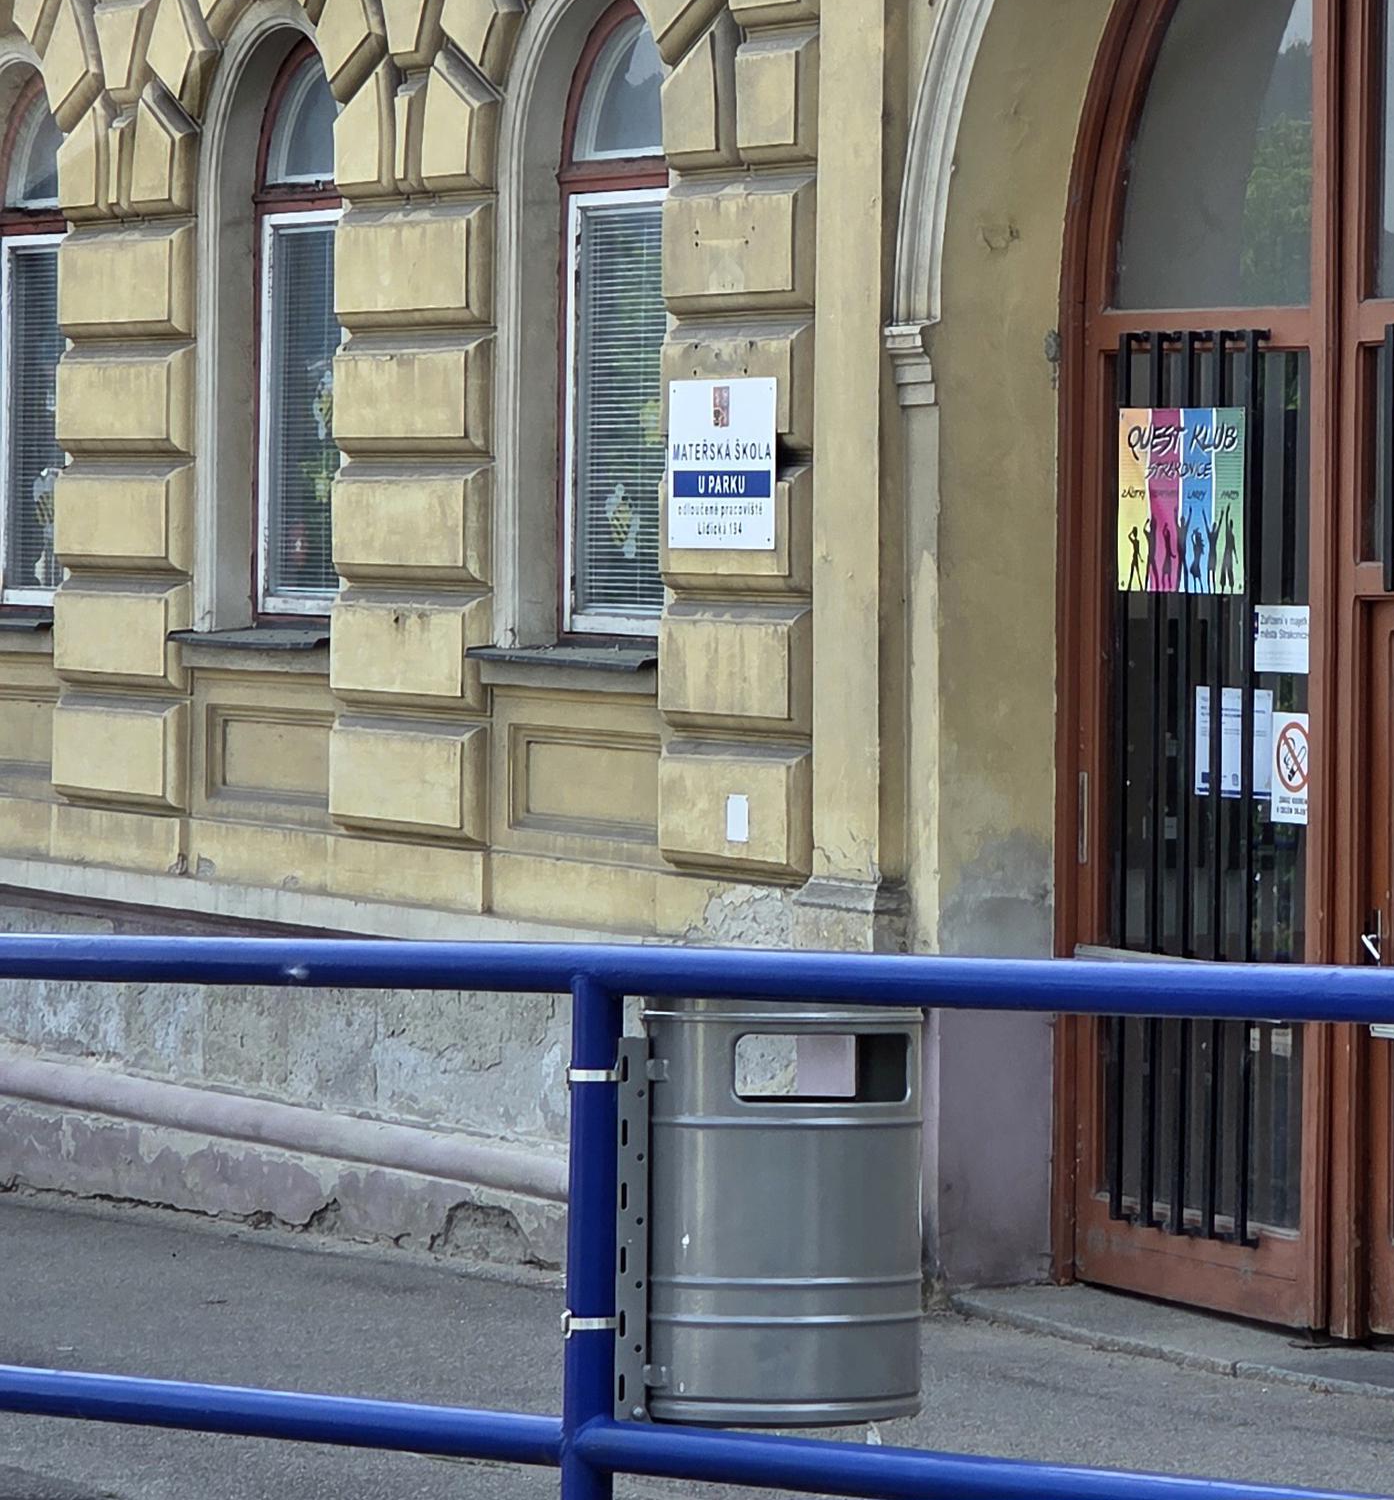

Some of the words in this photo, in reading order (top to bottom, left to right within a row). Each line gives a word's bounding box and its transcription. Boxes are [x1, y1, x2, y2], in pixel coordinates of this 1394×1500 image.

[672, 439, 731, 460] MATEŘSKÁ
[735, 439, 772, 460] ŠKOLA
[1128, 424, 1187, 461] QUEST
[1190, 423, 1238, 455] KLUB
[698, 475, 705, 494] U
[708, 475, 745, 494] PARKU
